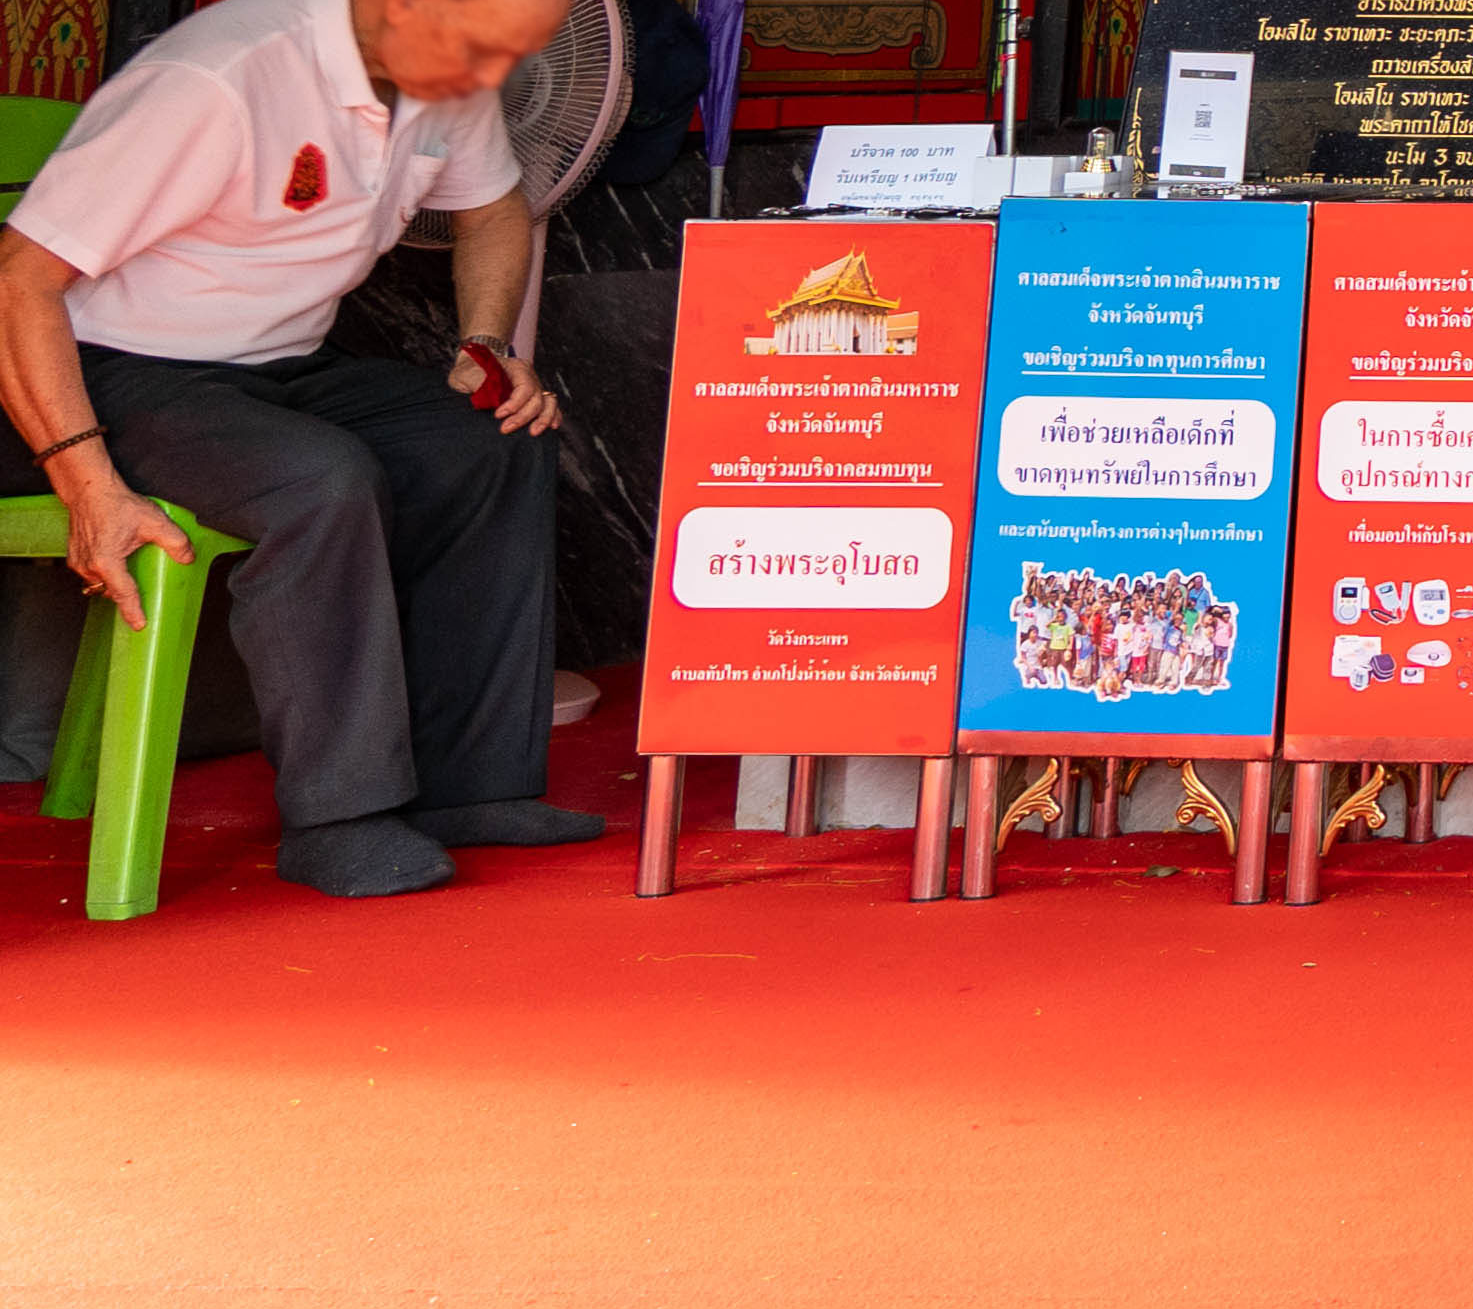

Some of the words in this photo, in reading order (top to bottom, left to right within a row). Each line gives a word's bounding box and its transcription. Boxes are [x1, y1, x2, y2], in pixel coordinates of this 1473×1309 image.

[1257, 17, 1316, 42] โอมสิโน
[1323, 26, 1392, 42] ราชาเทวะ
[1334, 82, 1393, 107] โอมสิโน
[1400, 91, 1470, 107] ราชาเทวะ
[850, 143, 895, 158] บริจาค
[900, 147, 919, 158] 100
[926, 146, 954, 157] บาท
[1386, 142, 1426, 166] นะโม
[1434, 148, 1448, 166] 3
[836, 169, 898, 187] รับเหรียญ
[903, 174, 909, 183] 1
[914, 167, 957, 186] เหรียญ
[1018, 266, 1281, 291] ศาลสมเด็จพระเจ้าตากสินมหาราช
[1087, 304, 1204, 329] จังหวัดจันทบุรี
[1022, 346, 1266, 372] ขอเชิญร่วมบริจาคทุนการศึกษา
[695, 375, 960, 399] ศาลสมเด็จพระเจ้าตากสินมหาราช
[766, 411, 883, 438] จังหวัดจันทบุรี
[1040, 407, 1235, 447] เพื่อช่วยเหลือเด็กที่
[711, 457, 933, 481] ขอเชิญร่วมบริจาคสมทบทุน
[1015, 459, 1257, 491] ขาดทุนทรัพย์ในการศึกษา
[999, 519, 1264, 545] และสนับสนุนโครงการต่างๆในการศึกษา
[708, 538, 920, 585] สร้างพระอุโบสถ
[767, 628, 849, 646] วัดวังกระแพร
[850, 663, 938, 686] จังหวัดจันทบุรี
